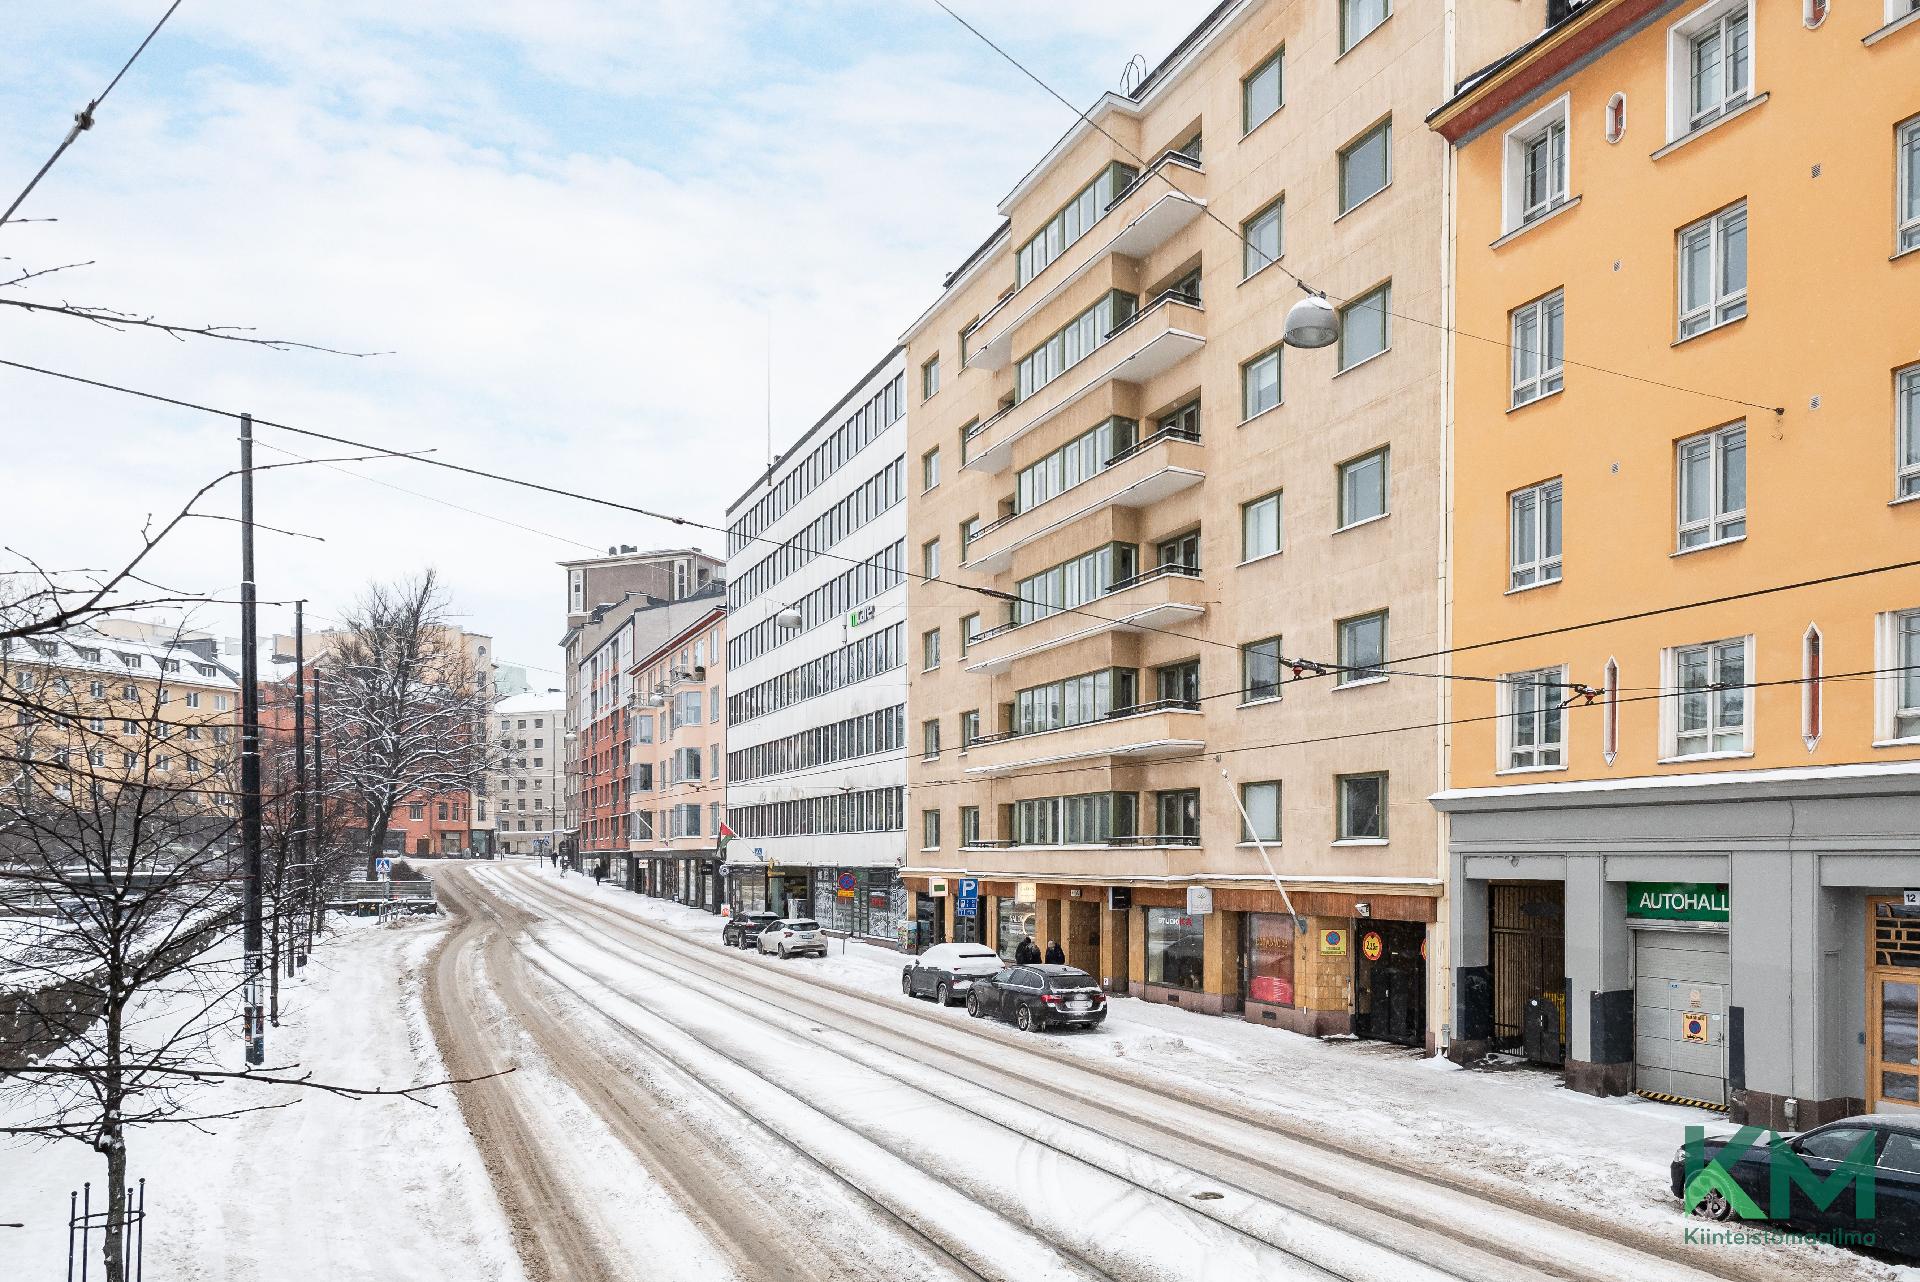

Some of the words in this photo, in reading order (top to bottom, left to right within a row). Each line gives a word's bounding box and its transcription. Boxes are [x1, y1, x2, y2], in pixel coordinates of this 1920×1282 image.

[962, 880, 975, 897] P
[1639, 892, 1730, 912] AUTOHALL
[1905, 893, 1917, 903] 12
